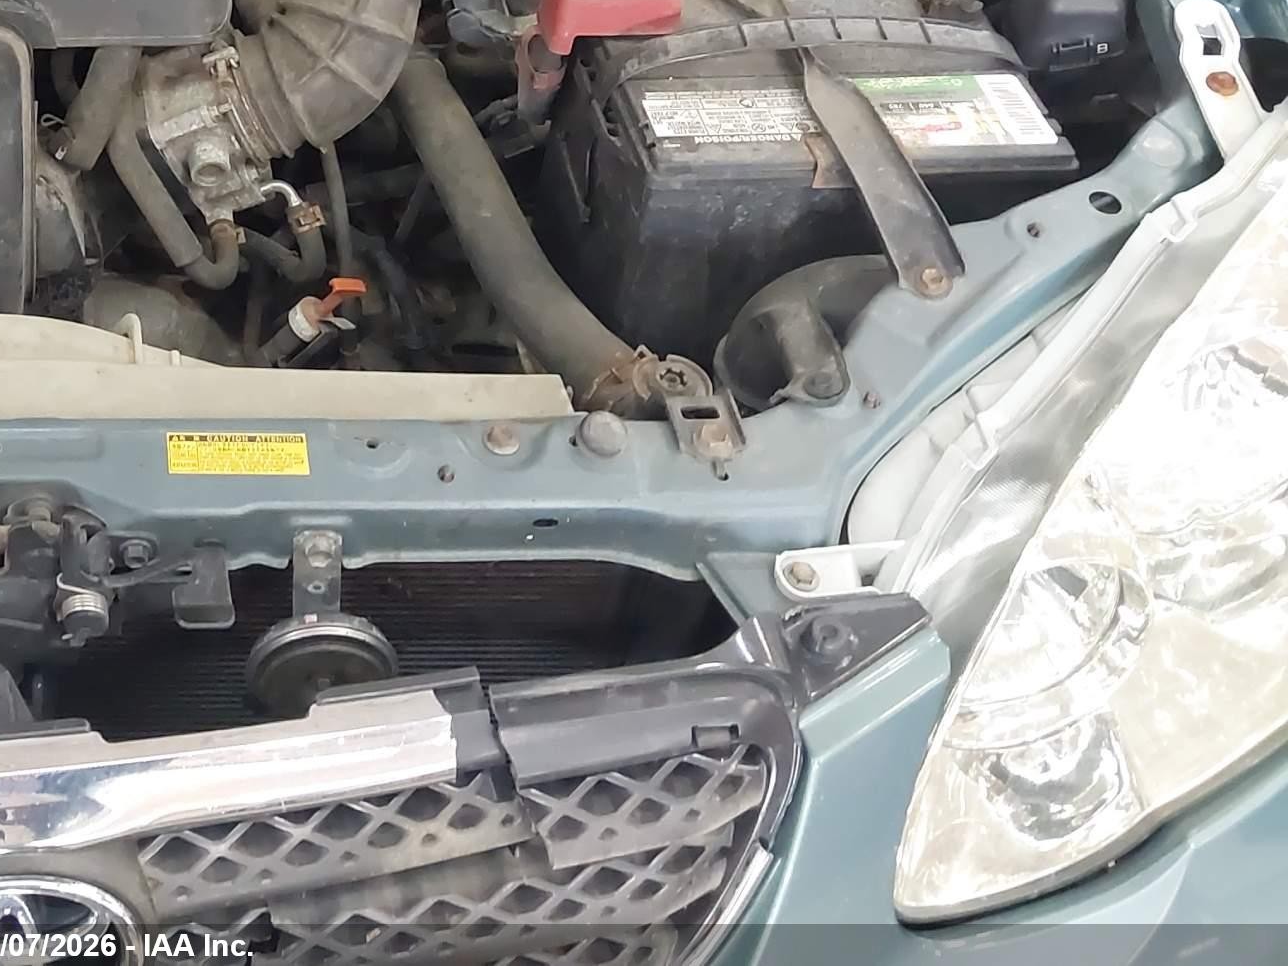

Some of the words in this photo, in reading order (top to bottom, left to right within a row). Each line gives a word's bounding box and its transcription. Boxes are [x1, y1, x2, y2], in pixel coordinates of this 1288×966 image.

[1096, 42, 1109, 54] B
[206, 434, 248, 442] CAUTION
[255, 435, 304, 443] ATTENTION
